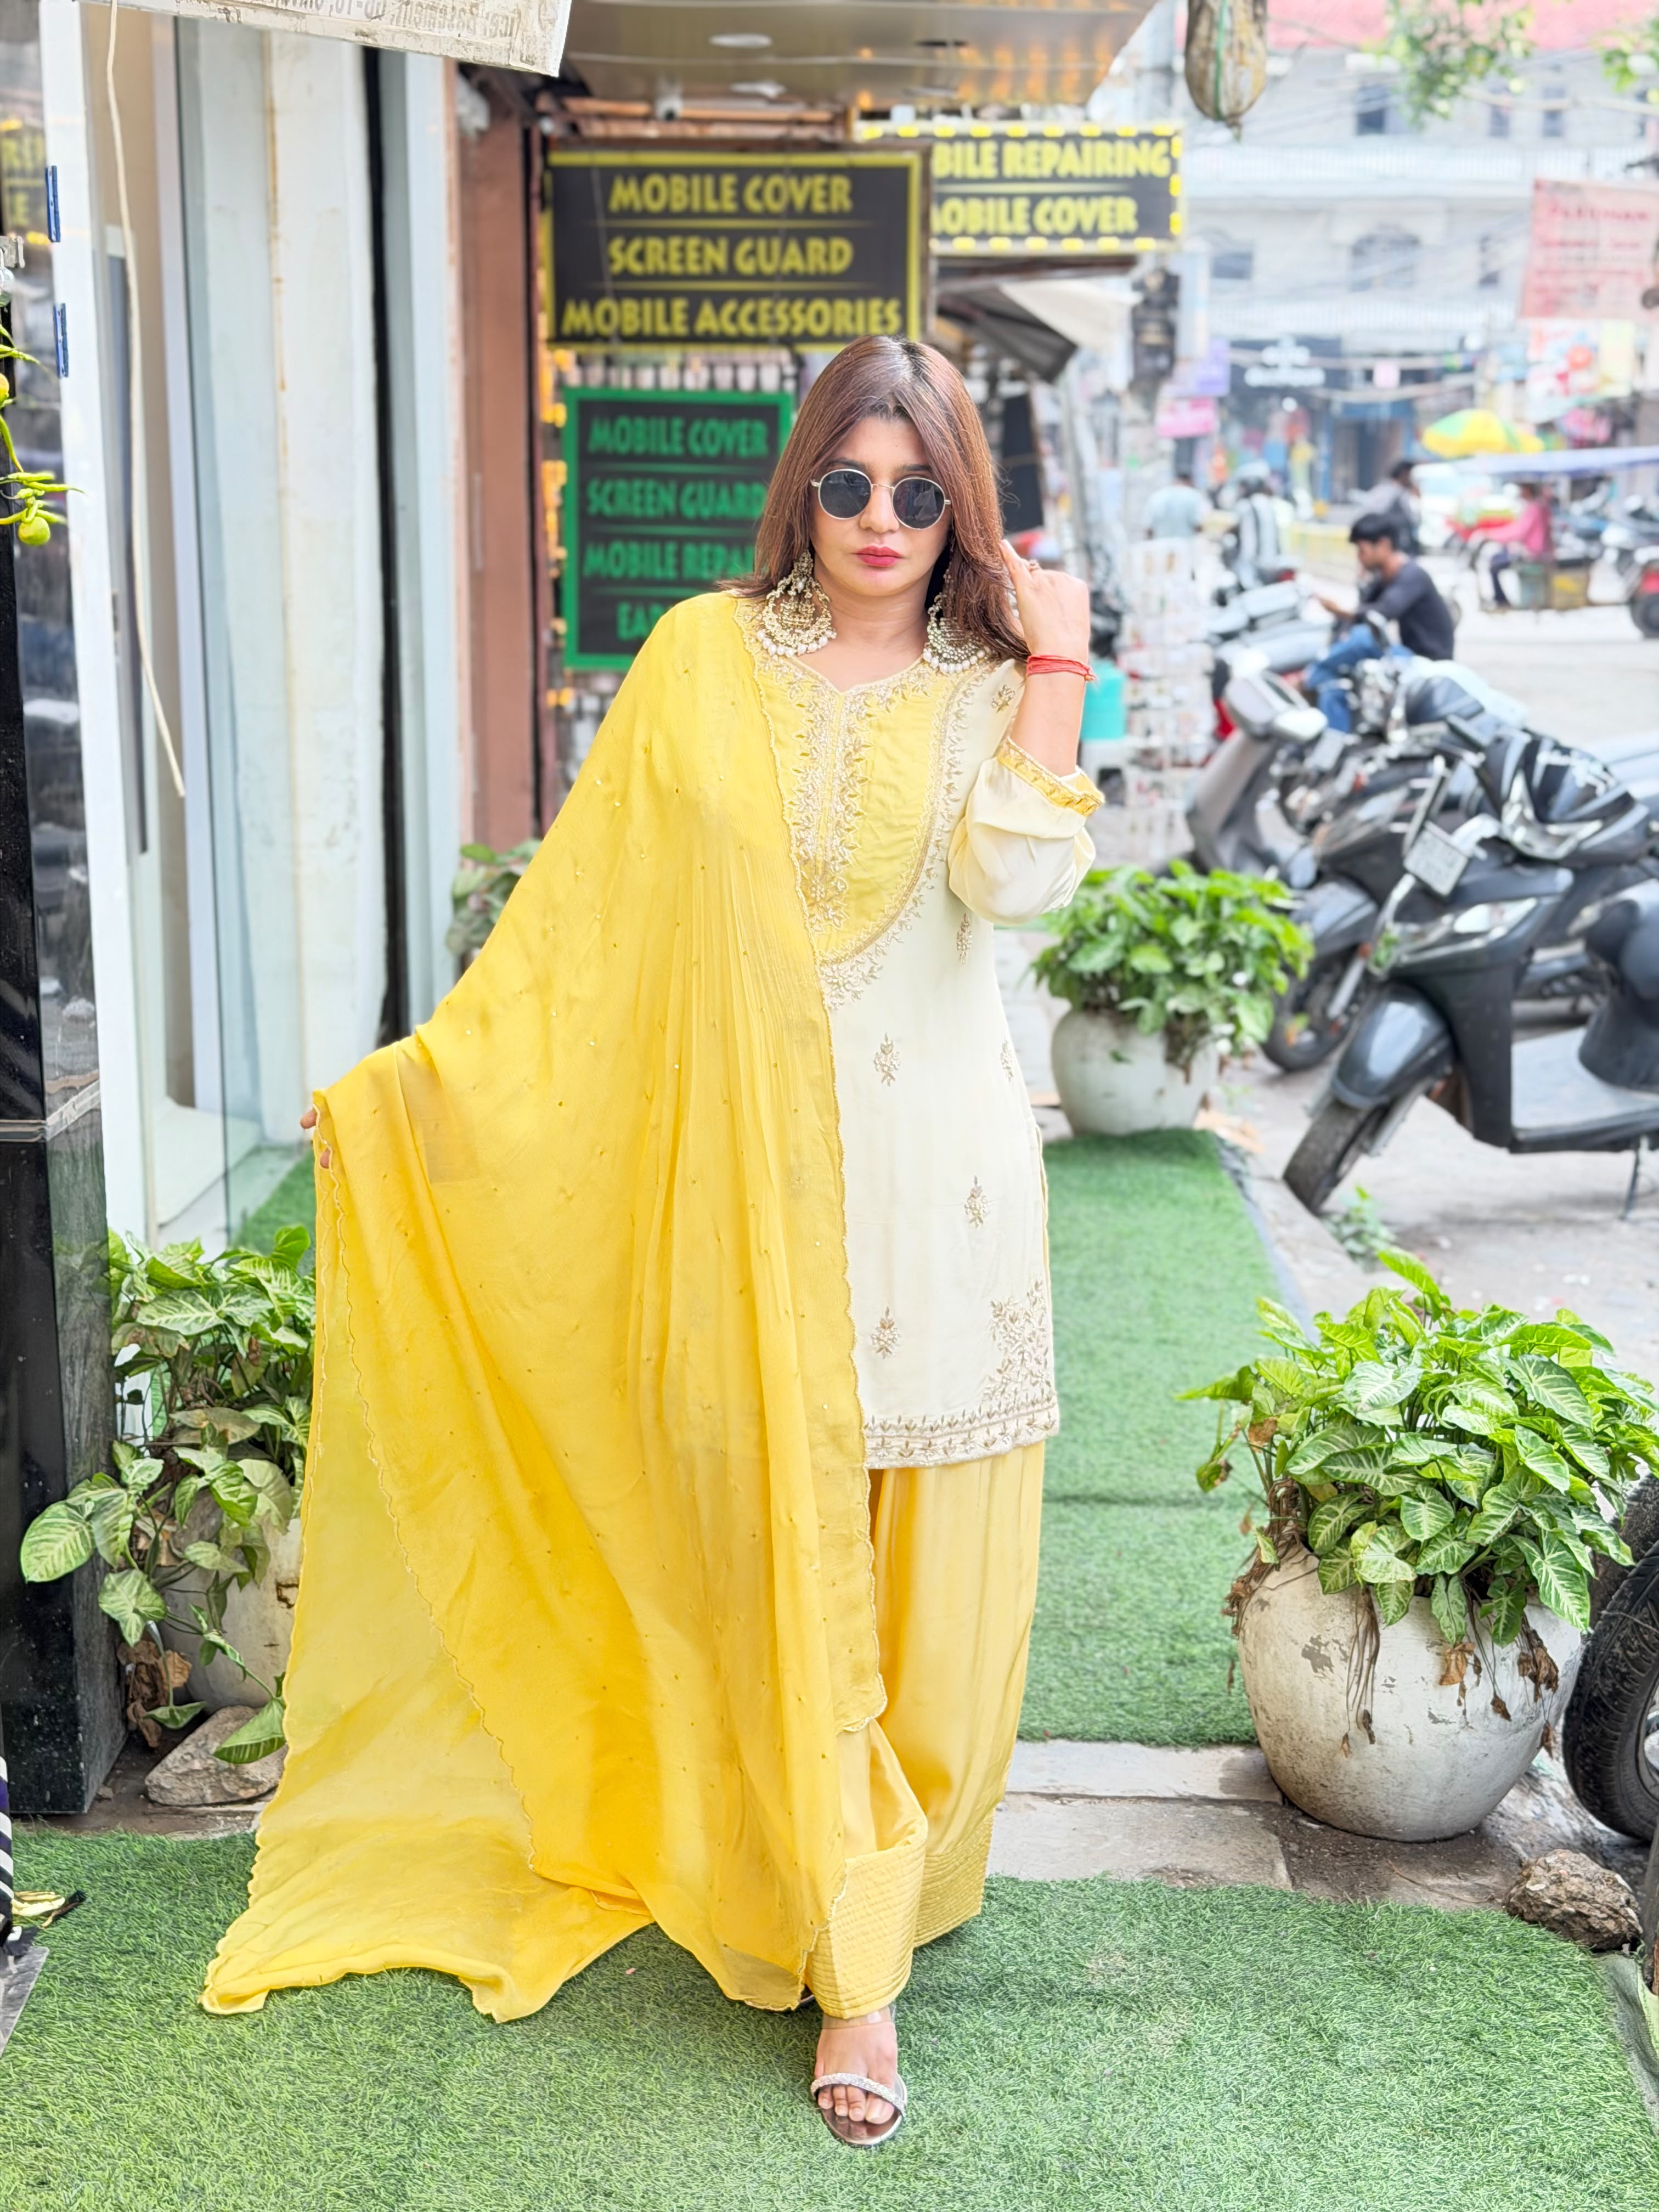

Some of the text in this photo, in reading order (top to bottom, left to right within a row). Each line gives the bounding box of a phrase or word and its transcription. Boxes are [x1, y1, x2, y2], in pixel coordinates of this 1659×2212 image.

[1002, 140, 1171, 178] REPAIRING
[608, 174, 850, 213] MOBILE COVER
[1033, 195, 1138, 234] COVER
[608, 236, 852, 275] SCREEN GUARD
[562, 298, 901, 336] MOBILE ACCESSORIES
[589, 415, 768, 456] MOBILE COVER
[587, 479, 766, 519] SCREEN GUARD
[583, 541, 676, 579] MOBILE
